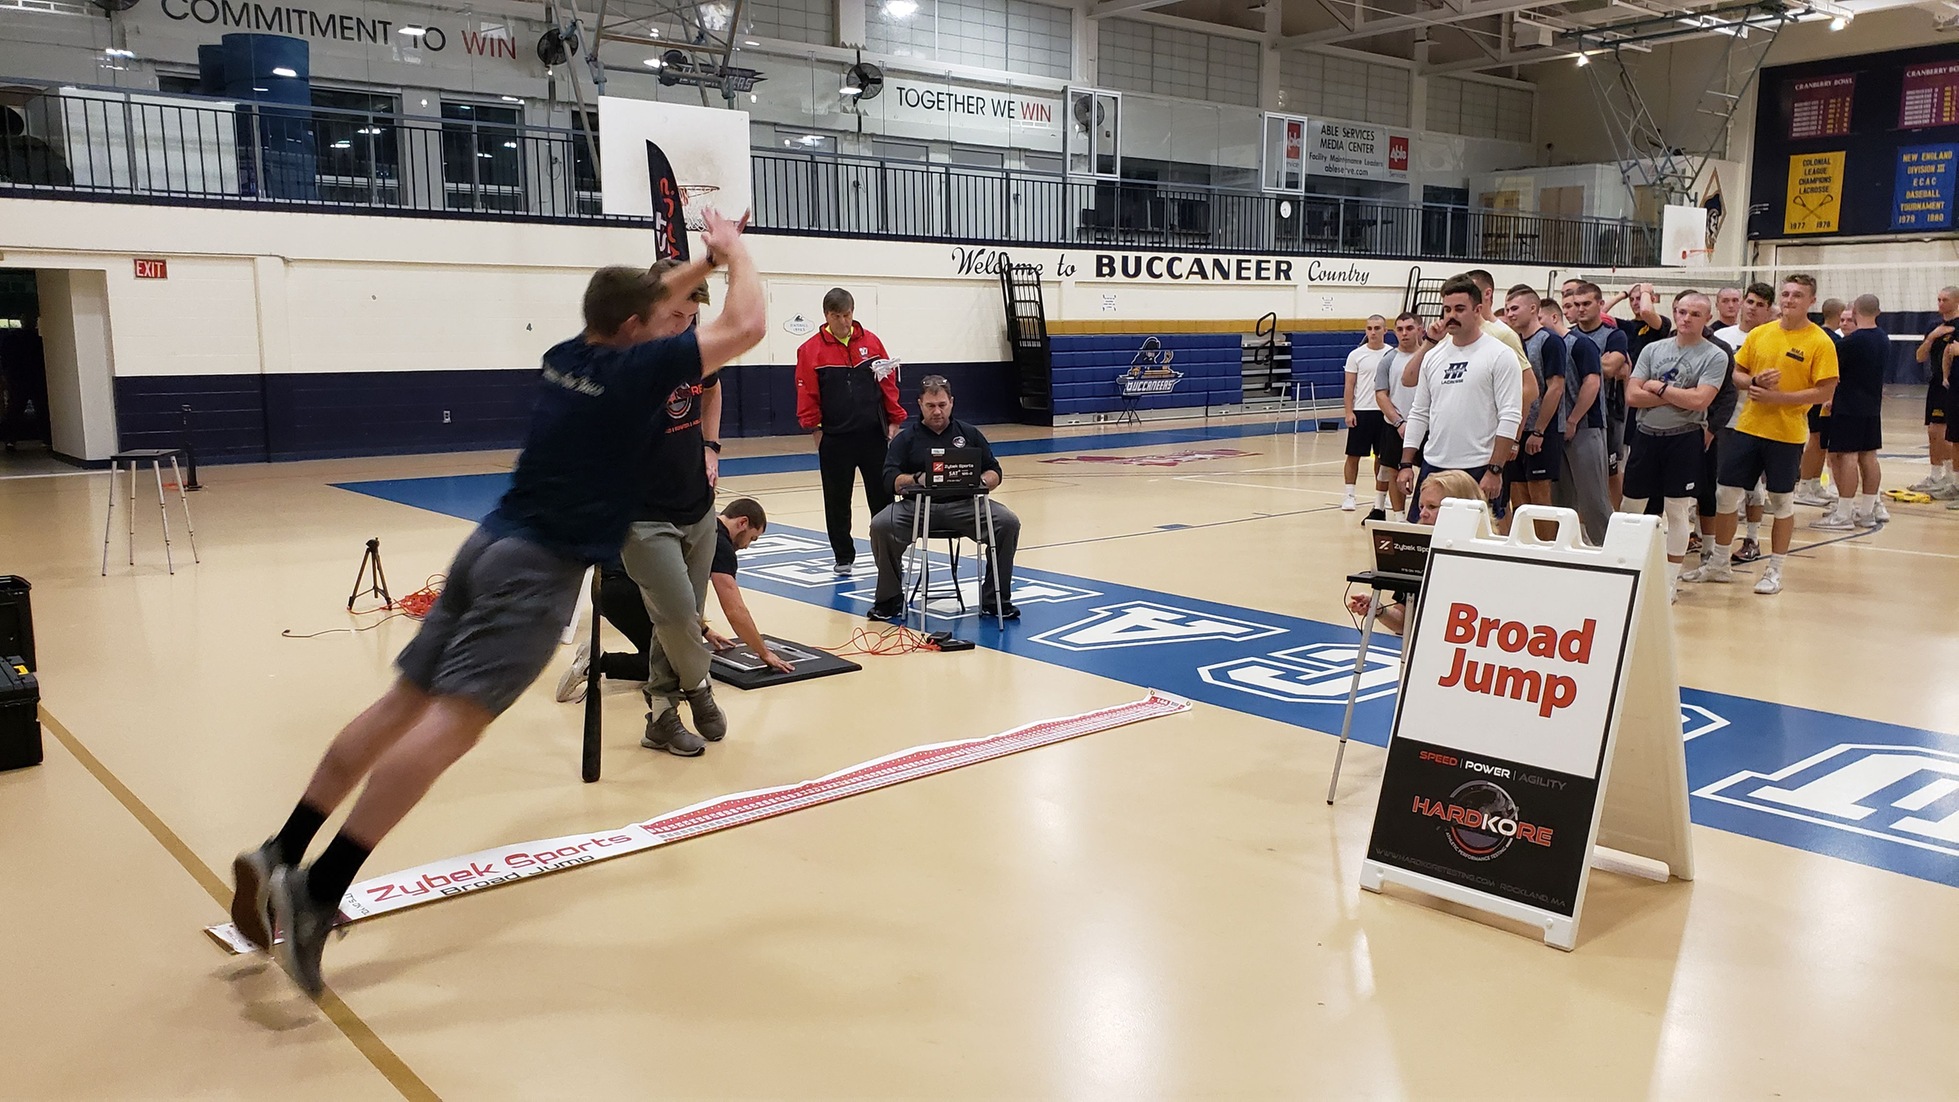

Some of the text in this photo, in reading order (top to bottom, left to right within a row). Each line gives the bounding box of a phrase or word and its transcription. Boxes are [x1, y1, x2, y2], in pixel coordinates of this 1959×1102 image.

[162, 0, 518, 60] COMMITMENT TO WIN
[1906, 66, 1948, 78] CRANBERRY
[1794, 77, 1853, 91] CRANBERRY BOWL
[896, 86, 1052, 123] TOGETHER WE WIN
[1320, 124, 1375, 141] ABLE SERVICES
[1320, 138, 1375, 154] MEDIA CENTER
[1309, 152, 1384, 167] Facility Maintenance Leaders
[1802, 157, 1831, 167] COLONIAL
[1903, 150, 1953, 163] NEW ENGLAND
[1324, 165, 1369, 177] ableserve.com
[1804, 167, 1828, 176] LEAGUE
[1907, 164, 1935, 175] DIVISION
[1798, 176, 1832, 186] CHAMPIONS
[1799, 186, 1830, 195] LACROSSE
[1905, 190, 1941, 199] BASEBALL
[1900, 202, 1945, 211] TOURNAMENT
[1790, 222, 1806, 230] 1977
[136, 260, 164, 278] EXIT
[1056, 253, 1078, 277] to
[1095, 254, 1294, 281] BUCCANEER
[1308, 260, 1371, 286] Country
[1126, 380, 1174, 393] BUCCANEERS
[1393, 542, 1430, 554] Zybek Spo
[1444, 602, 1597, 665] Broad
[1438, 647, 1577, 718] Jump
[1419, 750, 1567, 791] SPEED POWER AGILITY
[1411, 795, 1554, 847] HARDKORE
[1457, 849, 1491, 861] PERFORMANCE
[366, 833, 633, 902] Zybek Sports
[440, 854, 597, 897] Broad Jump
[1551, 897, 1567, 908] MA
